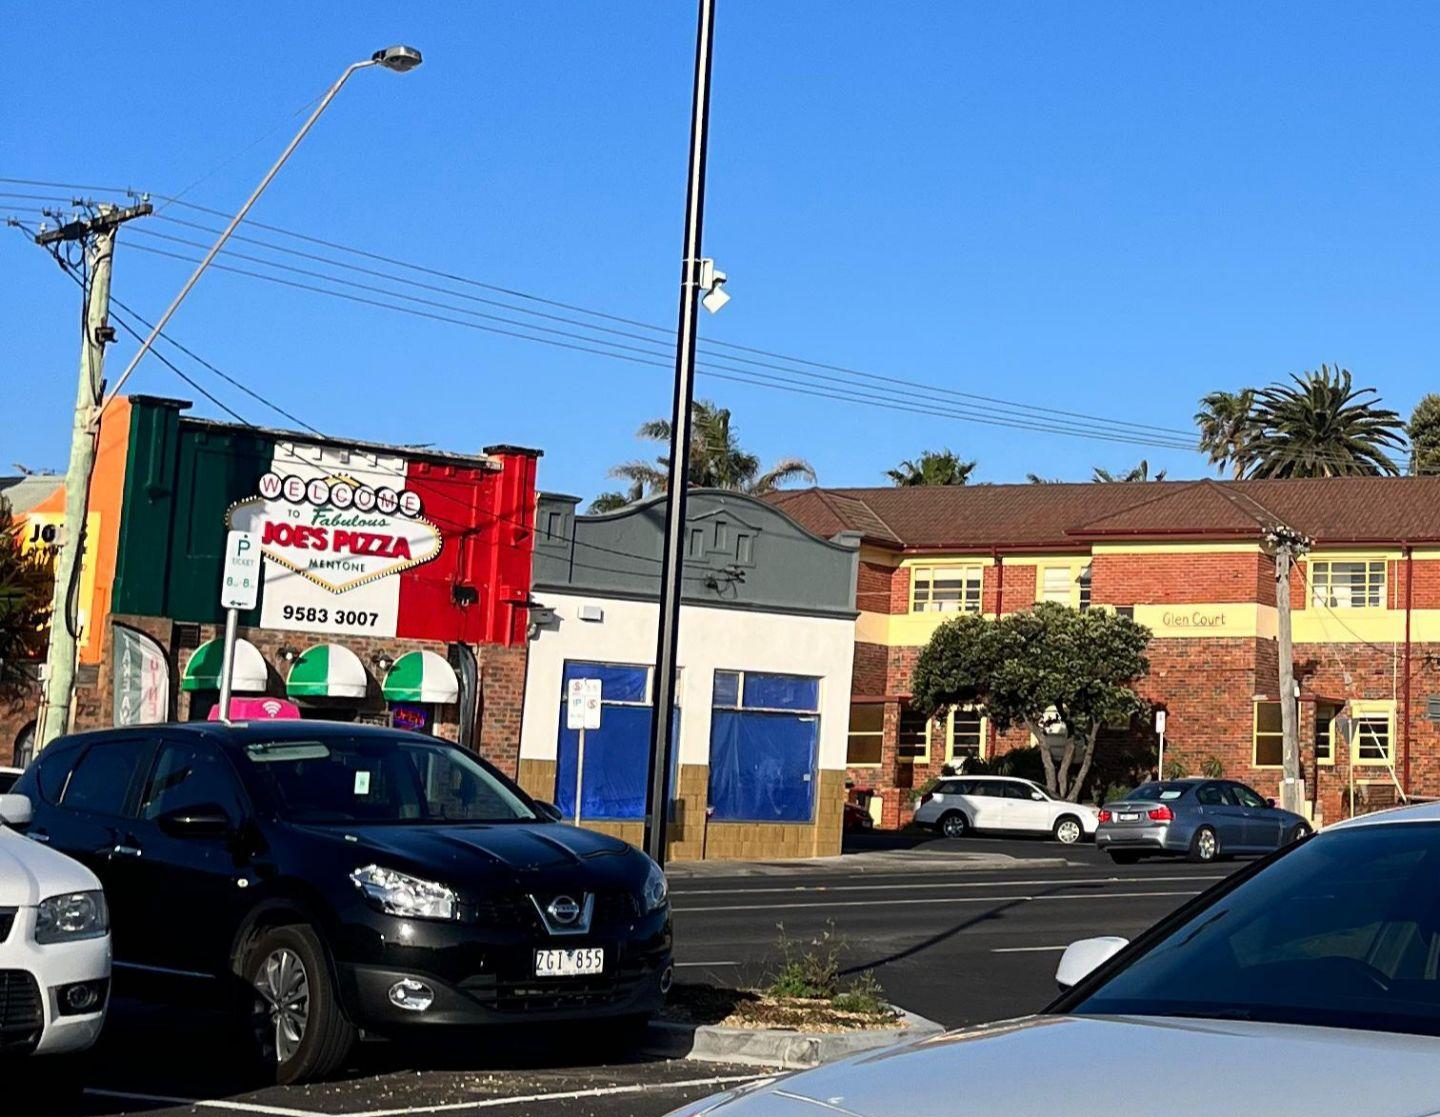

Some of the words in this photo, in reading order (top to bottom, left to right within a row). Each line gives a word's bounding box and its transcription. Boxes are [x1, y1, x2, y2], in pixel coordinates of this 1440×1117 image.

[262, 477, 417, 511] WELCOME
[288, 508, 300, 519] TO
[311, 507, 391, 527] Fabulous
[238, 539, 251, 557] P
[261, 520, 329, 551] JOE'S
[333, 529, 412, 560] PIZZA
[309, 557, 366, 573] MENTONE
[283, 604, 329, 624] 9583
[334, 607, 379, 627] 3007
[1162, 611, 1190, 626] Glen
[1192, 611, 1227, 626] Court
[576, 949, 602, 969] 855
